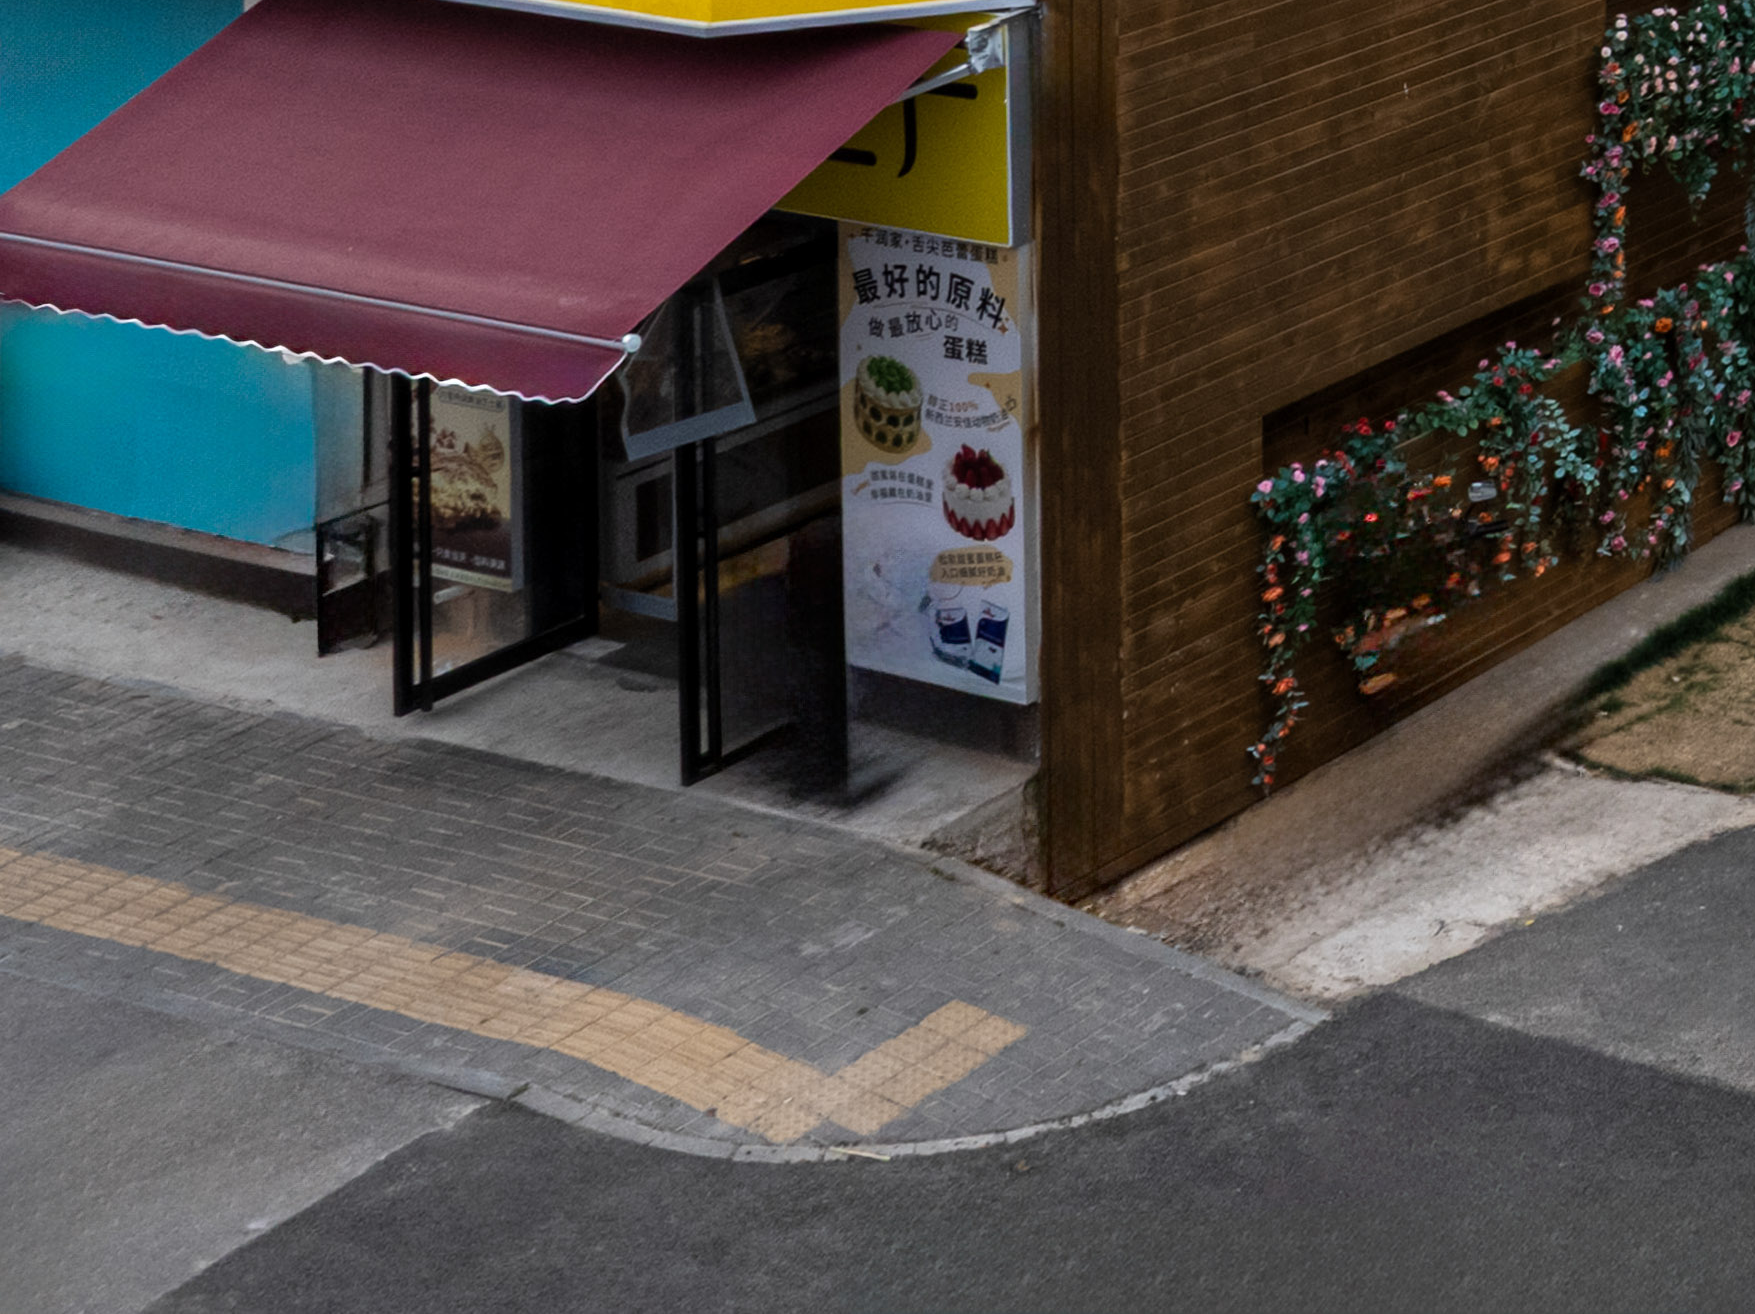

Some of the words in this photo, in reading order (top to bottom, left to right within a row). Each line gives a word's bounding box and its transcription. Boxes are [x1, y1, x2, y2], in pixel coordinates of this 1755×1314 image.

[853, 263, 1006, 329] 最好的原料
[868, 309, 960, 340] 做最放心的
[943, 335, 988, 365] 蛋糕
